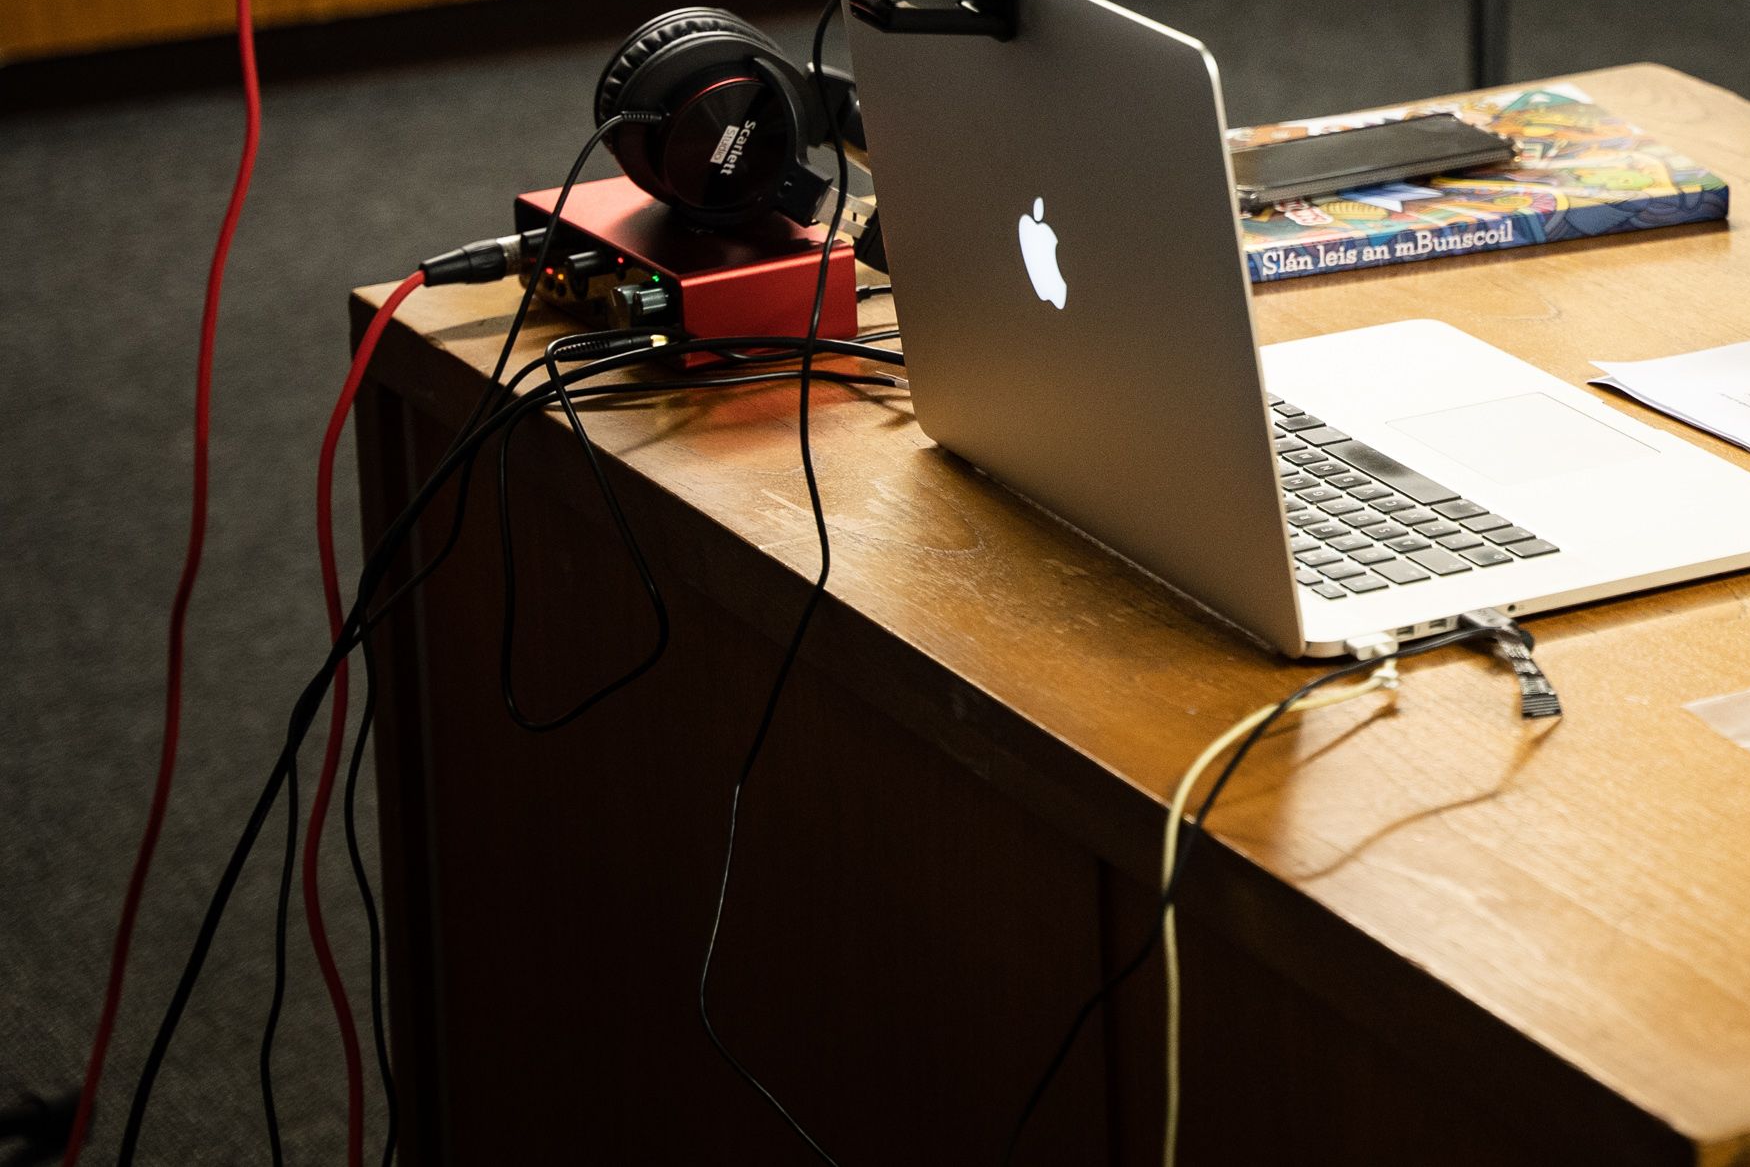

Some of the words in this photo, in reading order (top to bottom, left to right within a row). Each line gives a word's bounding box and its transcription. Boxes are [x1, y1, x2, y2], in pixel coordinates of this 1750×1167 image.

[720, 119, 757, 175] Scarlett
[1262, 250, 1313, 276] Slán
[1317, 245, 1358, 268] leis
[1362, 245, 1390, 261] an
[1394, 221, 1513, 257] mBunscoil
